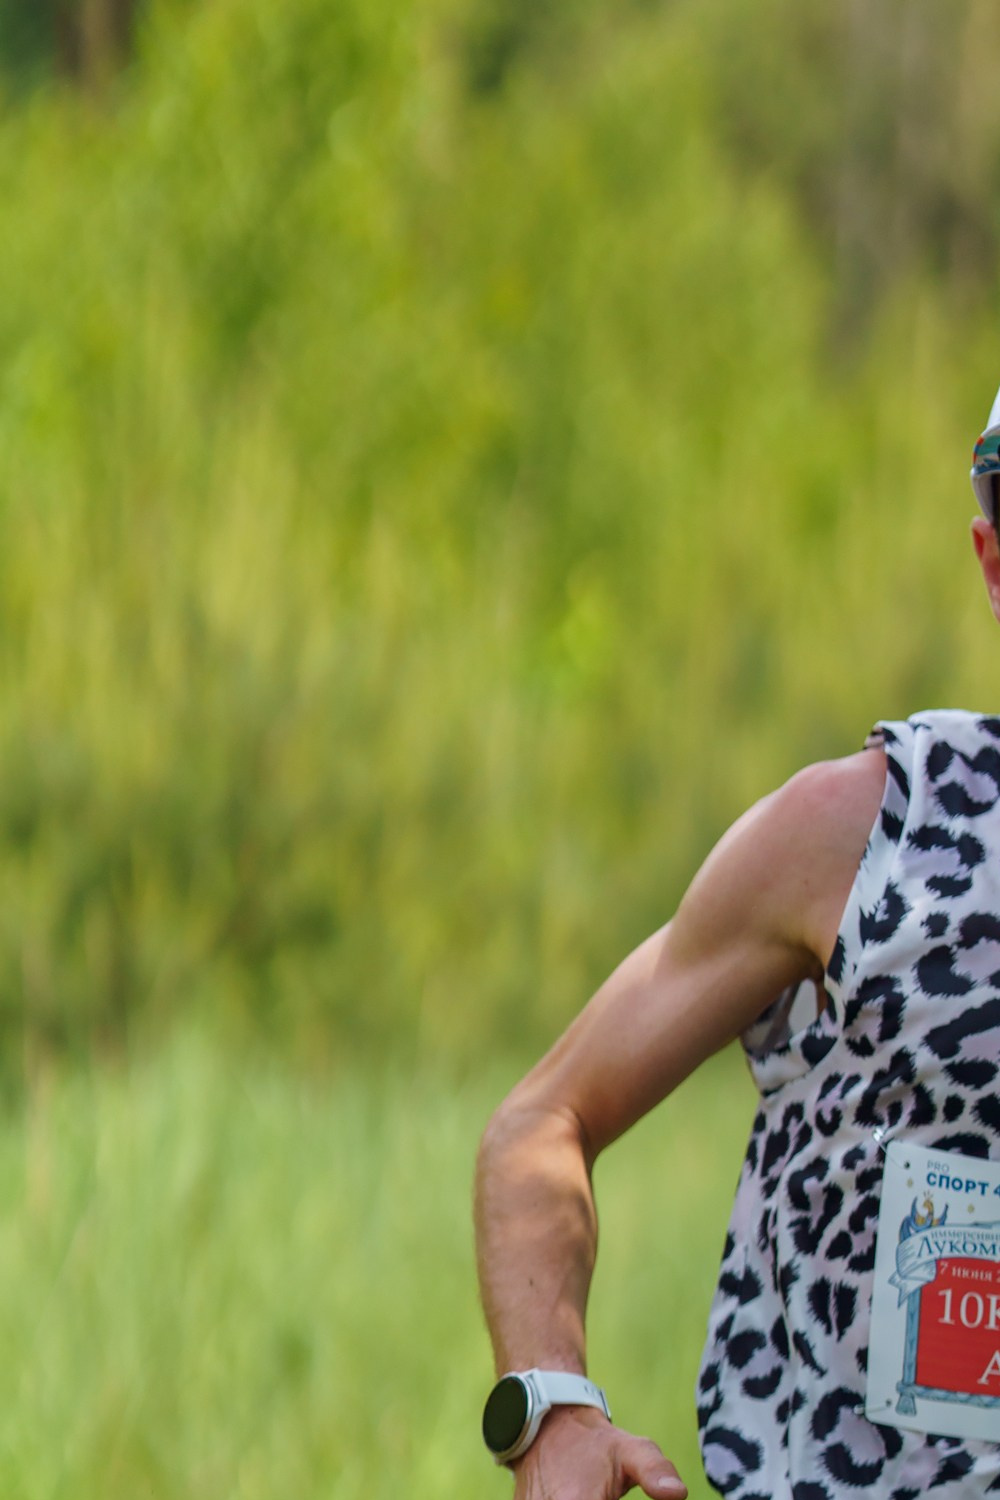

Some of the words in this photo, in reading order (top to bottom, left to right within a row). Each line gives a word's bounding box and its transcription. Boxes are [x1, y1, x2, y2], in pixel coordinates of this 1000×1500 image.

[926, 1172, 989, 1196] СПОРТ
[939, 1261, 949, 1275] 7
[952, 1266, 993, 1283] июня
